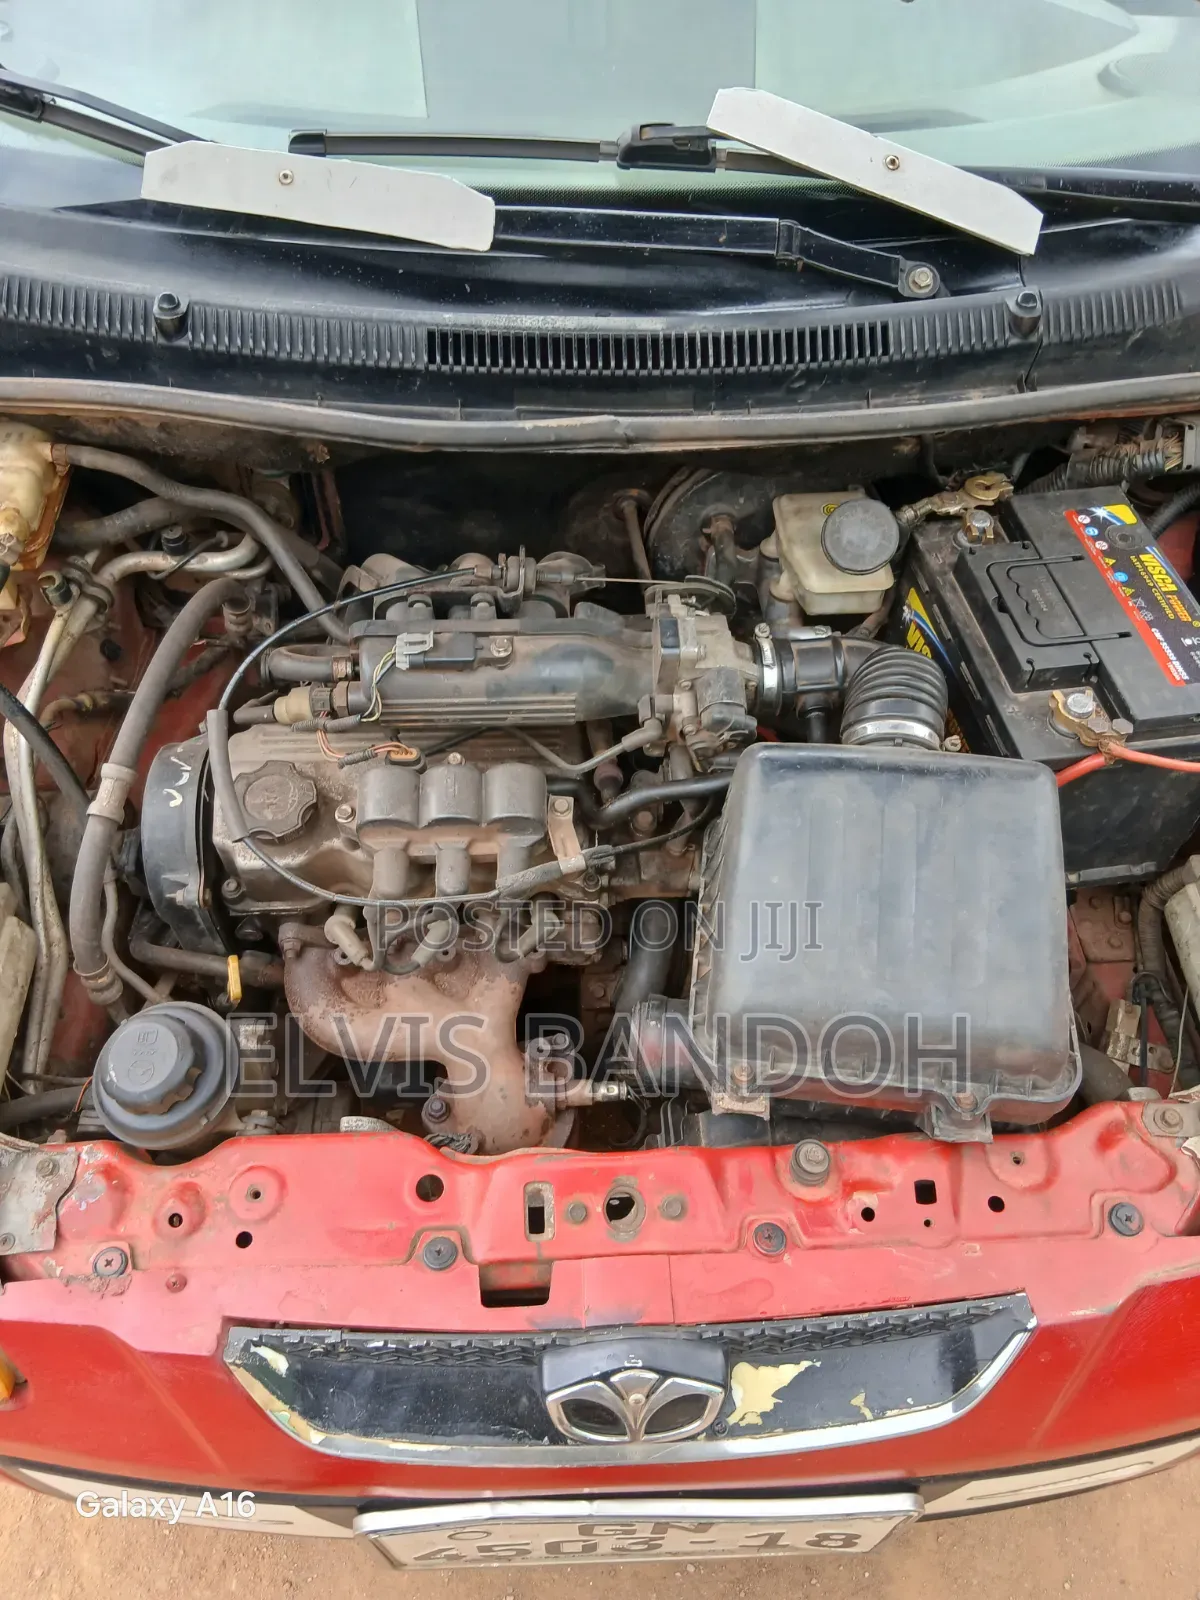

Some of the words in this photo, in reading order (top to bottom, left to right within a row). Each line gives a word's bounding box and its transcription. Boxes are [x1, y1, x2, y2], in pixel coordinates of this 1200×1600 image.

[1139, 553, 1178, 592] VISCA
[1165, 594, 1192, 622] POWER
[1151, 588, 1176, 620] CERTIFIED
[578, 1521, 716, 1537] GN
